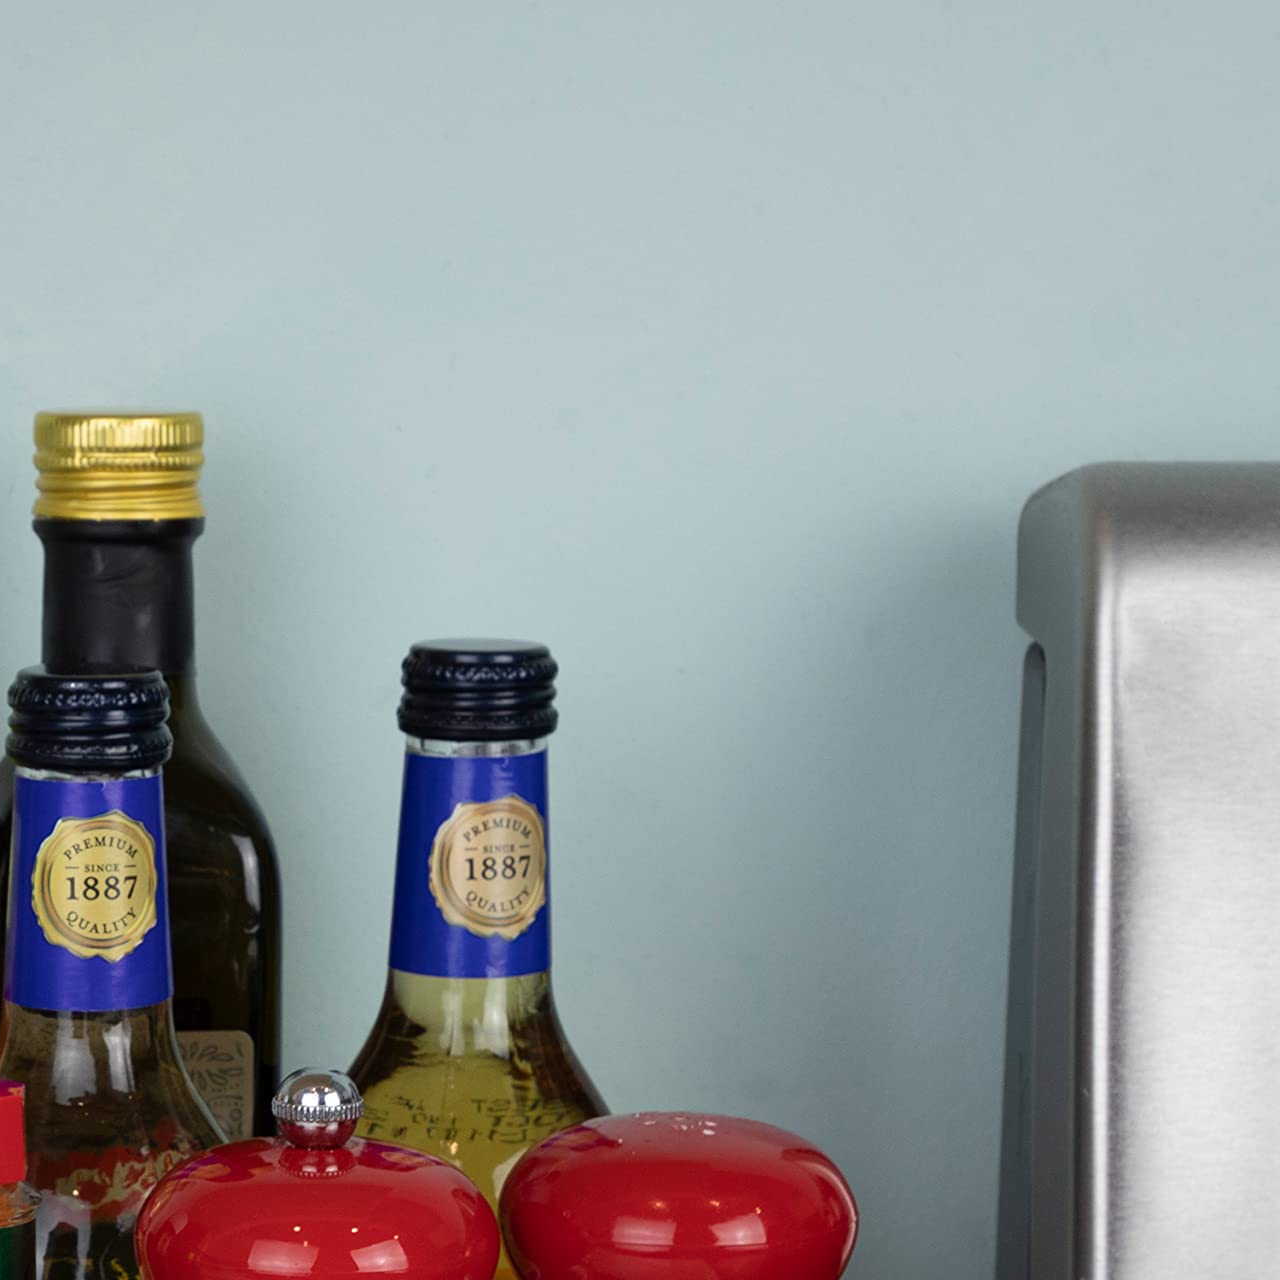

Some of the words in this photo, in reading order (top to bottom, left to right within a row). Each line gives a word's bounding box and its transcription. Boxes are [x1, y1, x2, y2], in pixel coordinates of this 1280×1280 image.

[463, 818, 532, 842] PREMIUM
[63, 835, 138, 860] PREMIUM
[483, 844, 515, 853] SINCE
[84, 863, 120, 873] SINCE
[465, 855, 531, 881] 1887
[65, 875, 138, 901] 1887
[465, 886, 529, 912] QUALITY
[66, 907, 137, 934] QUALITY
